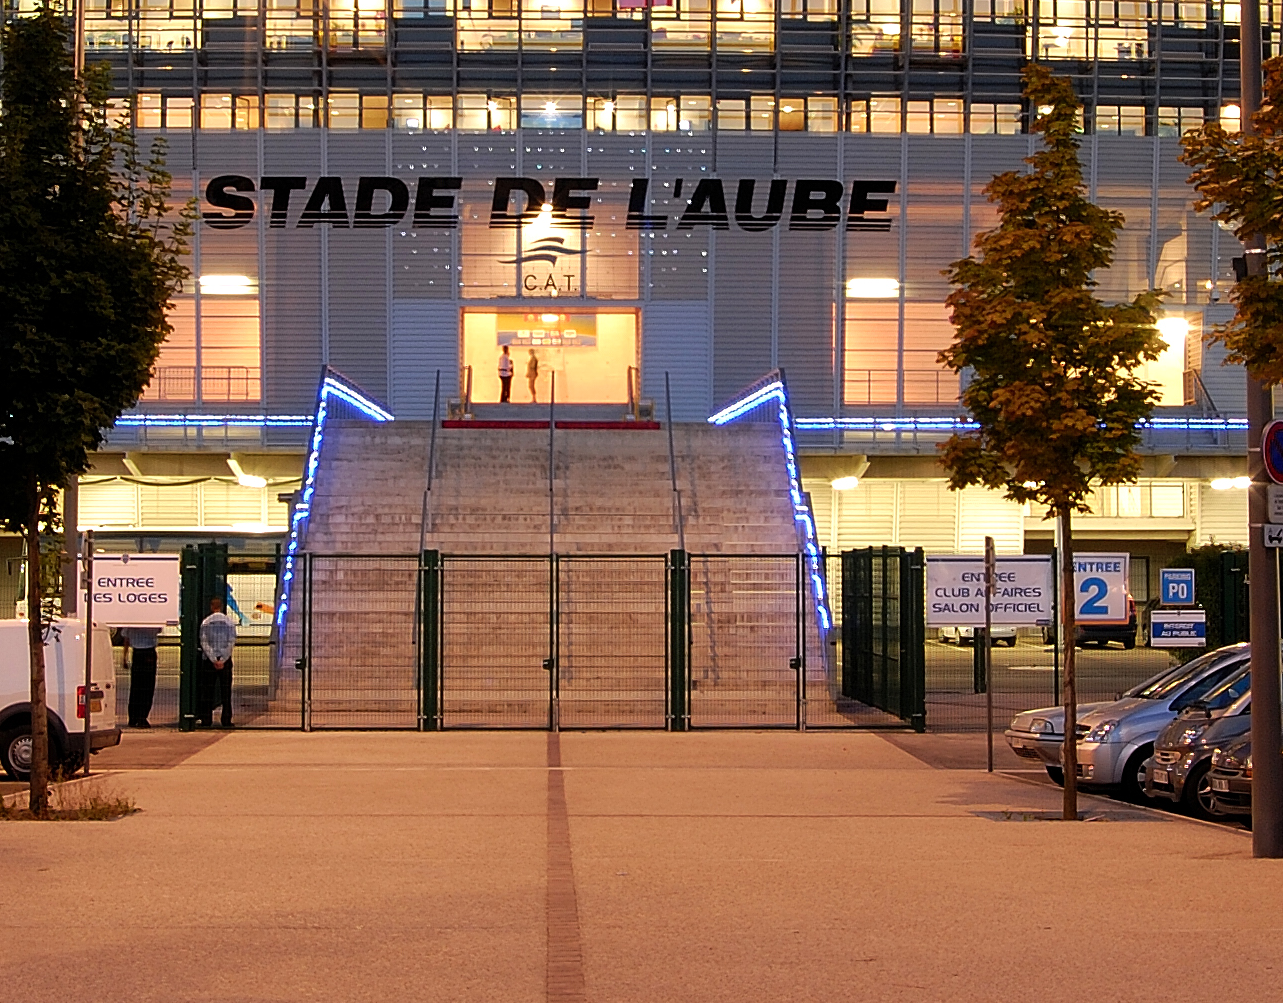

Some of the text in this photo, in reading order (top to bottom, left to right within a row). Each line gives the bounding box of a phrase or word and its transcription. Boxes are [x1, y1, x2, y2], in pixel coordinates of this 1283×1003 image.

[202, 176, 898, 232] STADE DE L'AUBE
[524, 273, 577, 291] C.A.T.
[98, 577, 155, 588] ENTREE
[118, 593, 168, 603] LOGES
[935, 588, 1042, 598] CLUB AFAIRES
[1079, 577, 1109, 615] 2
[932, 603, 980, 613] SALON
